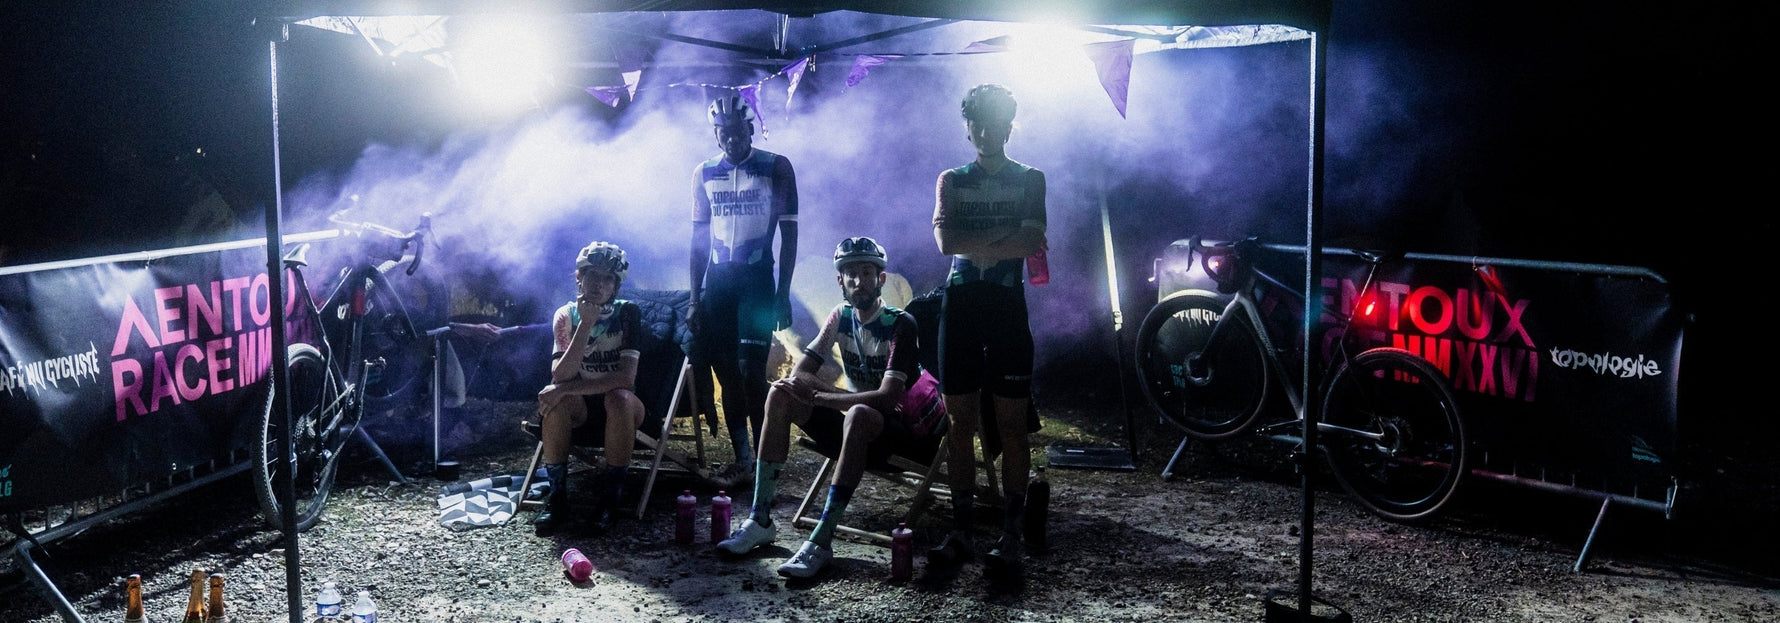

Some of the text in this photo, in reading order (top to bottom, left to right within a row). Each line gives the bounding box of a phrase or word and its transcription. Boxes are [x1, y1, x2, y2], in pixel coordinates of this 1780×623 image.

[712, 189, 762, 204] TOPOLOGIE
[723, 203, 766, 217] CYCLISTE
[45, 341, 100, 388] CYCLISTE
[111, 336, 235, 422] RACE
[1549, 346, 1662, 380] topologie
